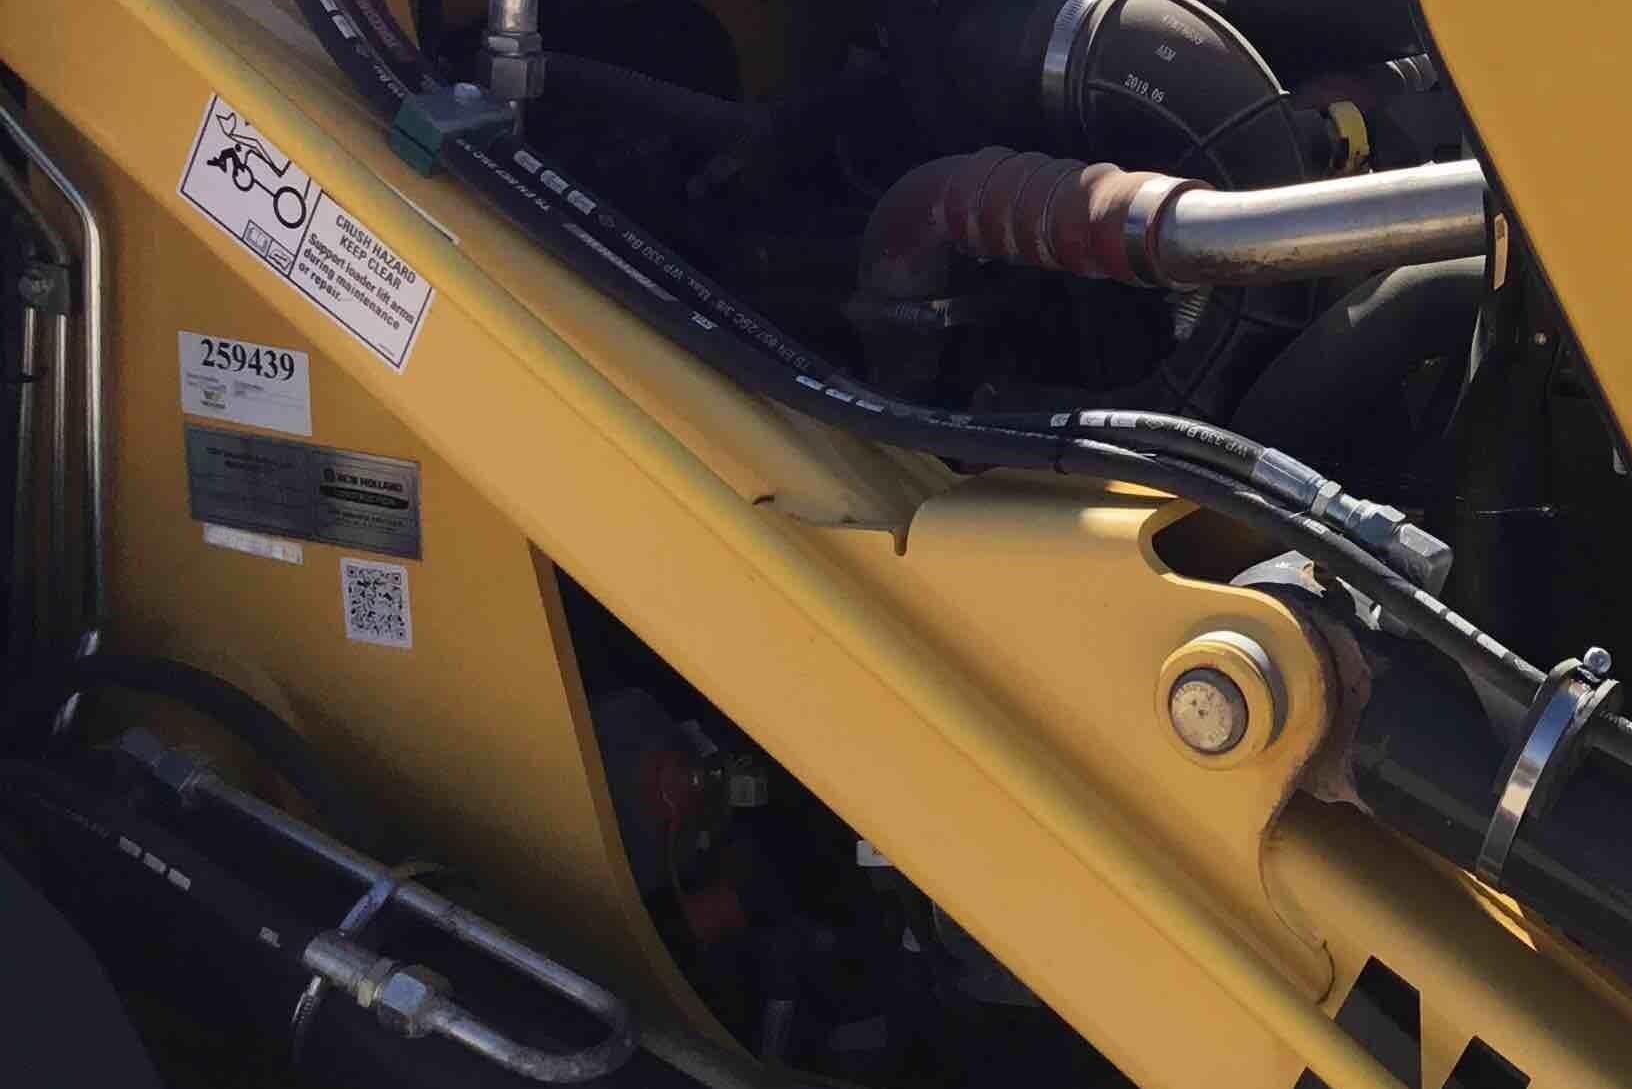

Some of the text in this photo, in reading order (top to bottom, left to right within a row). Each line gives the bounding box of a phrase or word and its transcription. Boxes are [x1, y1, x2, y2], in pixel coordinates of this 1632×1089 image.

[308, 233, 416, 325] Support loader lift arms
[336, 214, 416, 284] CRUSH HAZARD
[339, 235, 402, 290] KEEP CLEAR
[298, 263, 342, 302] or repair.
[303, 248, 400, 330] during maintenance
[200, 338, 295, 381] 259439
